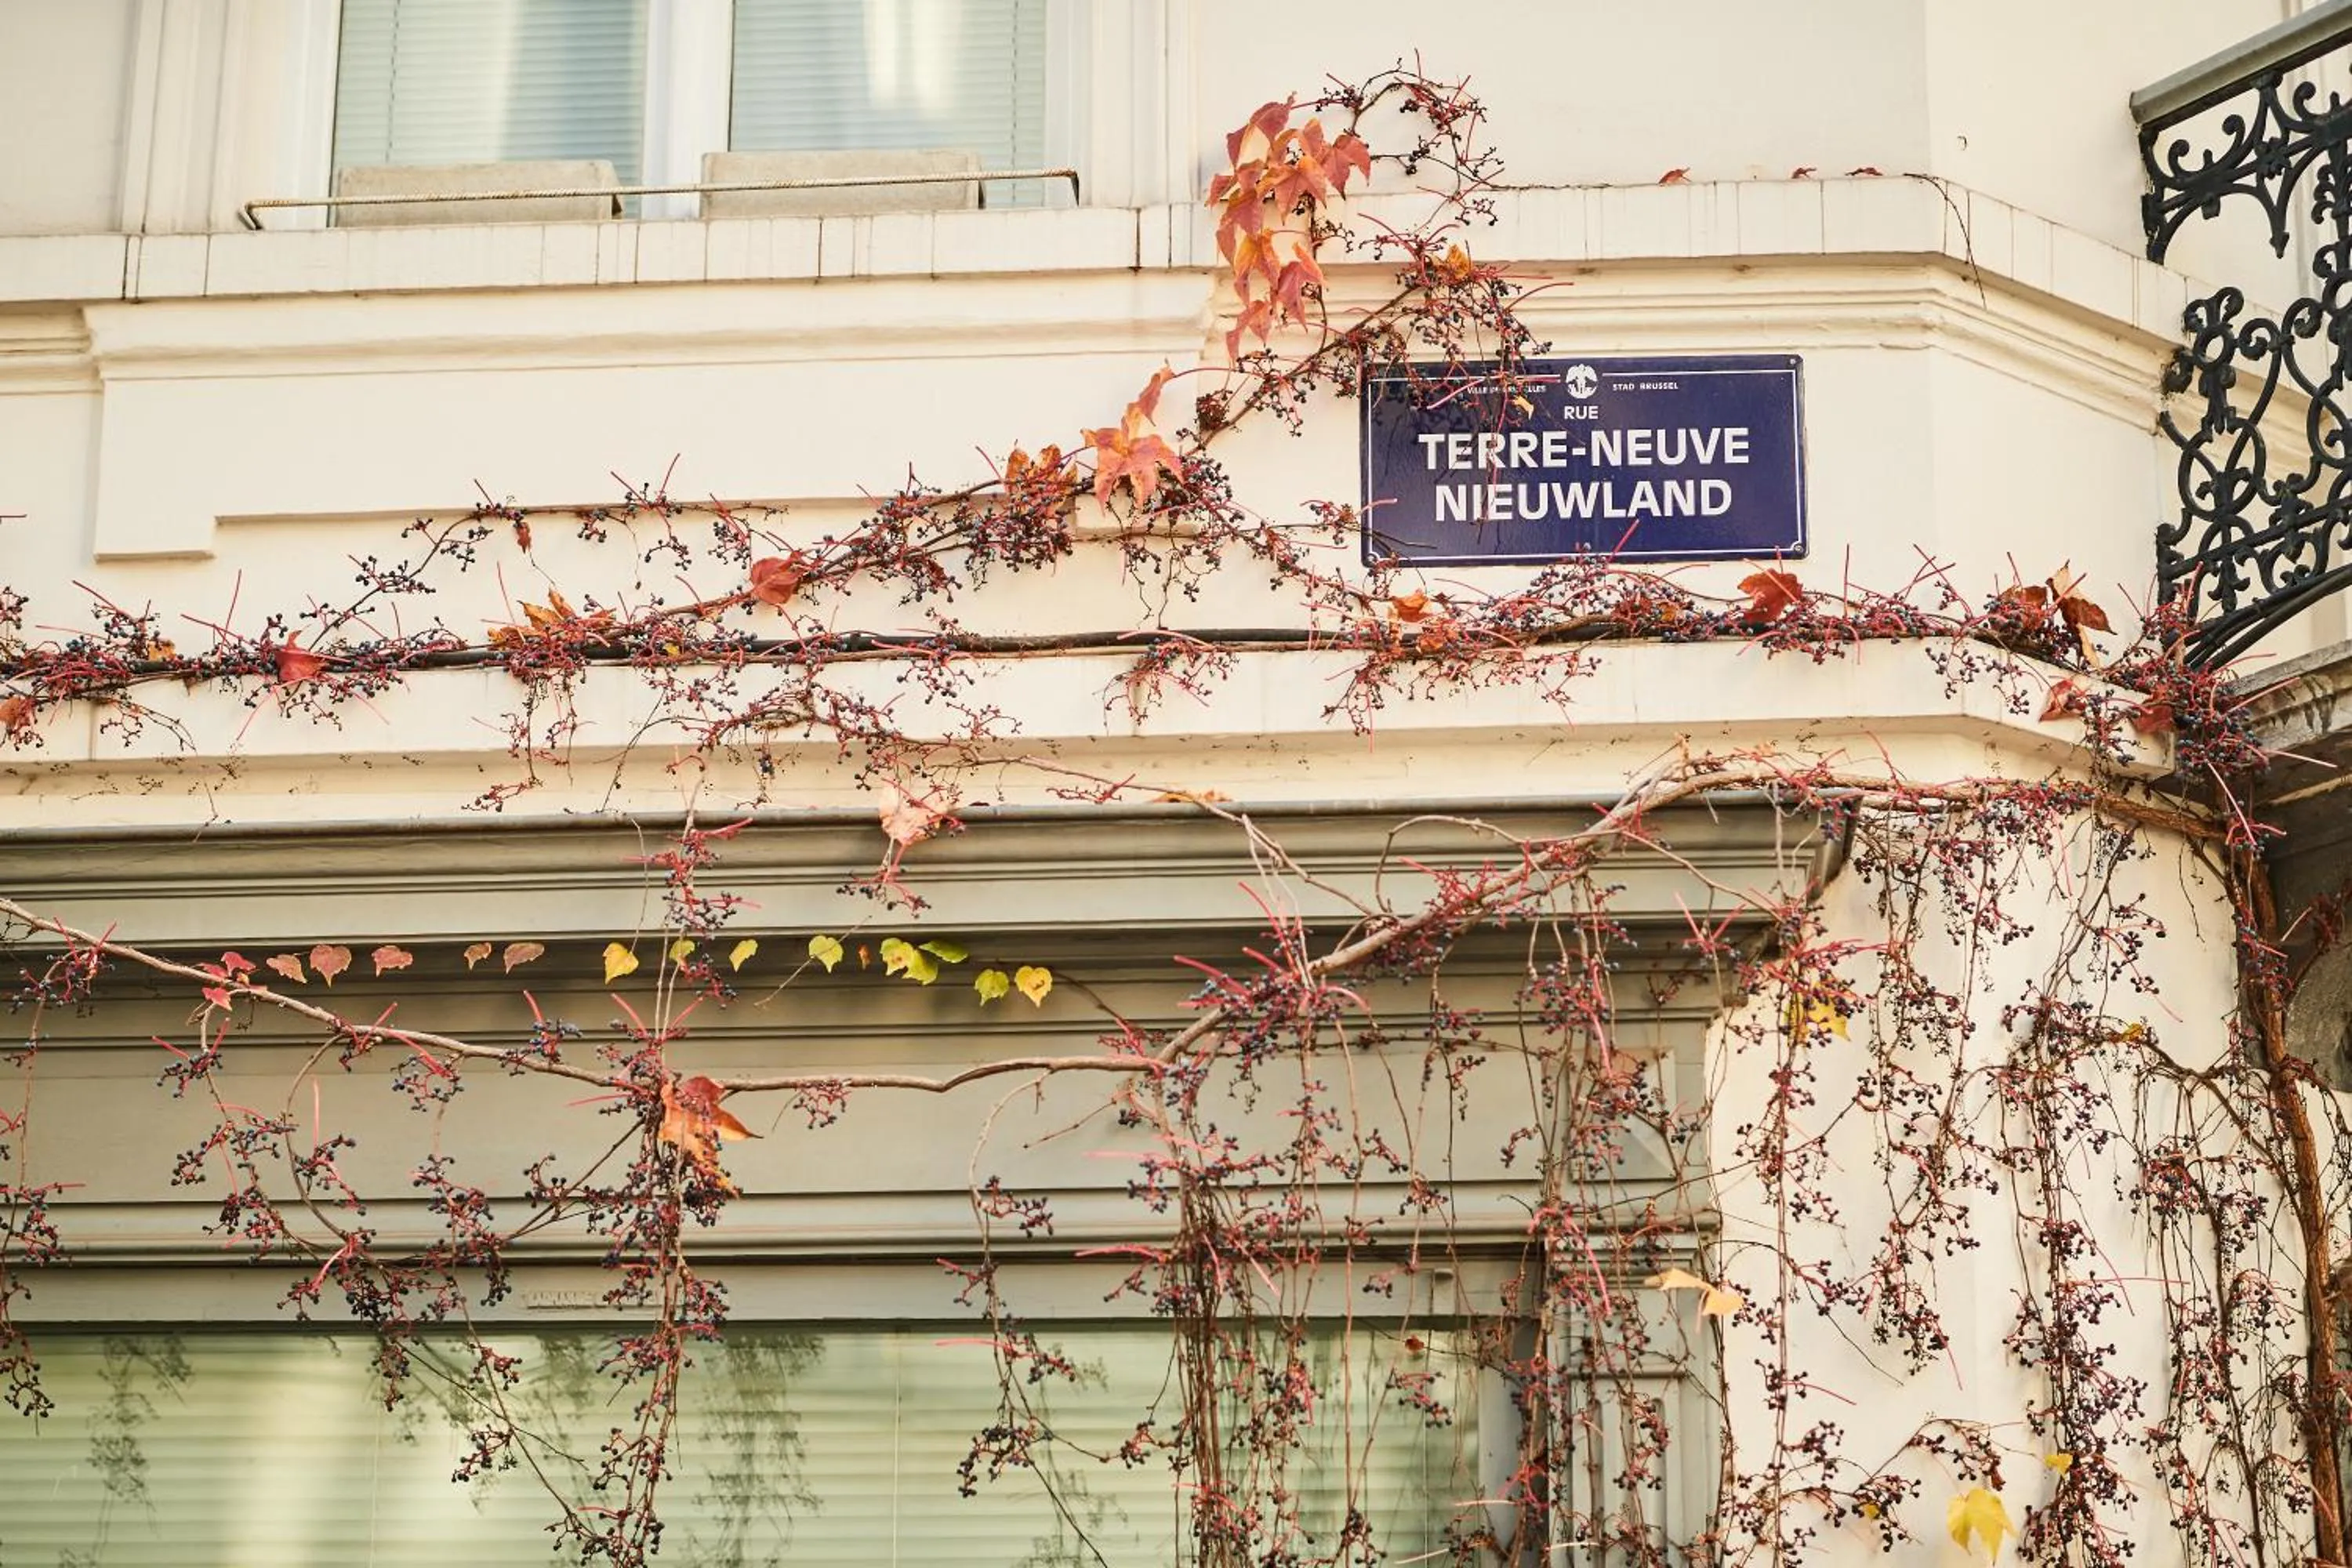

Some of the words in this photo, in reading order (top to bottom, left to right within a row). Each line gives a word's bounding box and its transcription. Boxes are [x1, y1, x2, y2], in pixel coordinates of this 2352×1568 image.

[1613, 383, 1635, 391] STAD
[1564, 405, 1599, 419] RUE
[1418, 427, 1749, 470] TERRE-NEUVE
[1436, 479, 1732, 521] NIEUWLAND
